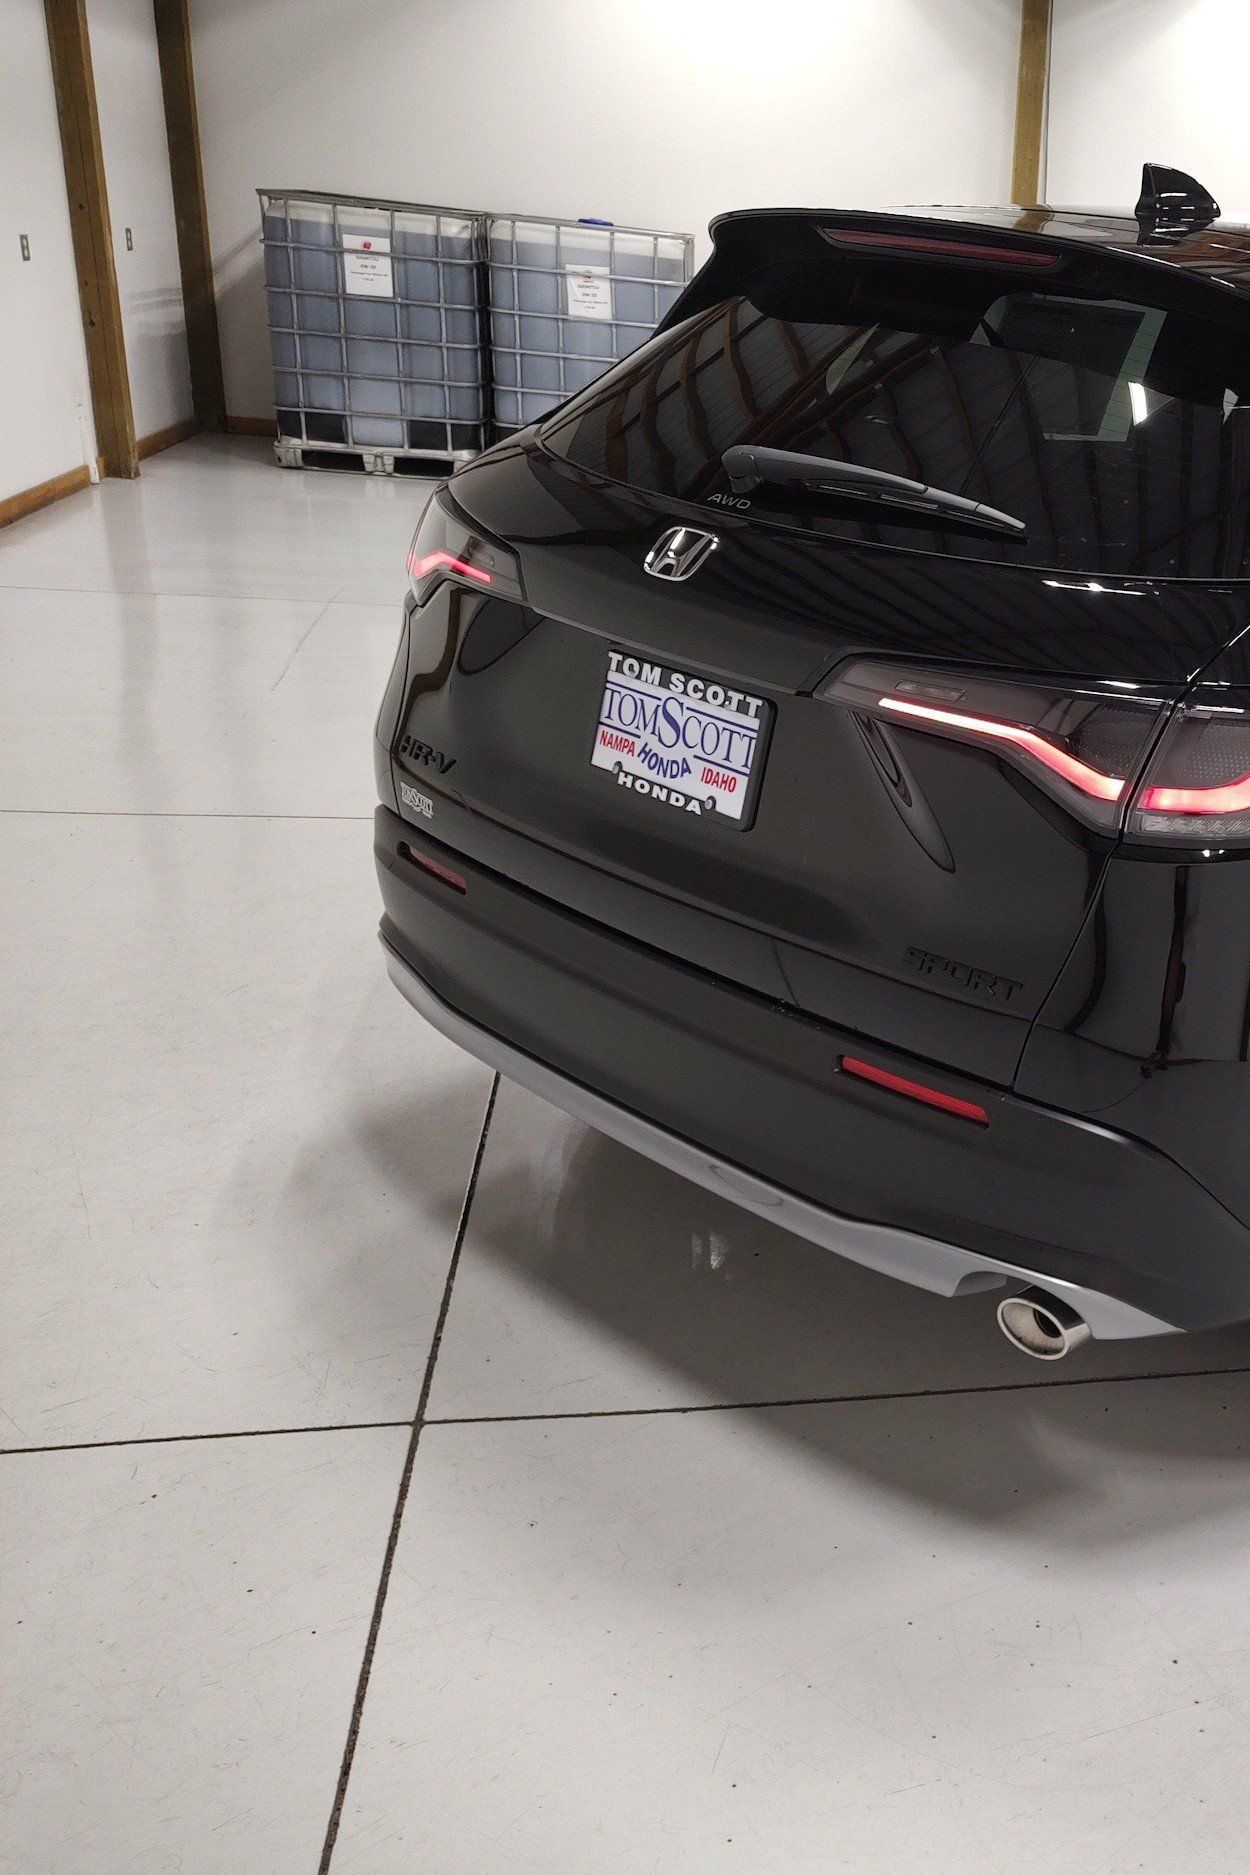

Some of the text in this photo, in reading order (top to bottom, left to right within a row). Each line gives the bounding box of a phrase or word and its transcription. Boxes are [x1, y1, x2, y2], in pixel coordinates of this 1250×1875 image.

[706, 493, 751, 509] AWD
[607, 651, 764, 719] TOM SCOTT
[598, 730, 637, 757] NAMPA
[636, 742, 692, 779] HONDA
[617, 771, 702, 816] HONDA
[700, 766, 738, 793] IDAHO
[902, 946, 1025, 1000] SPORT
